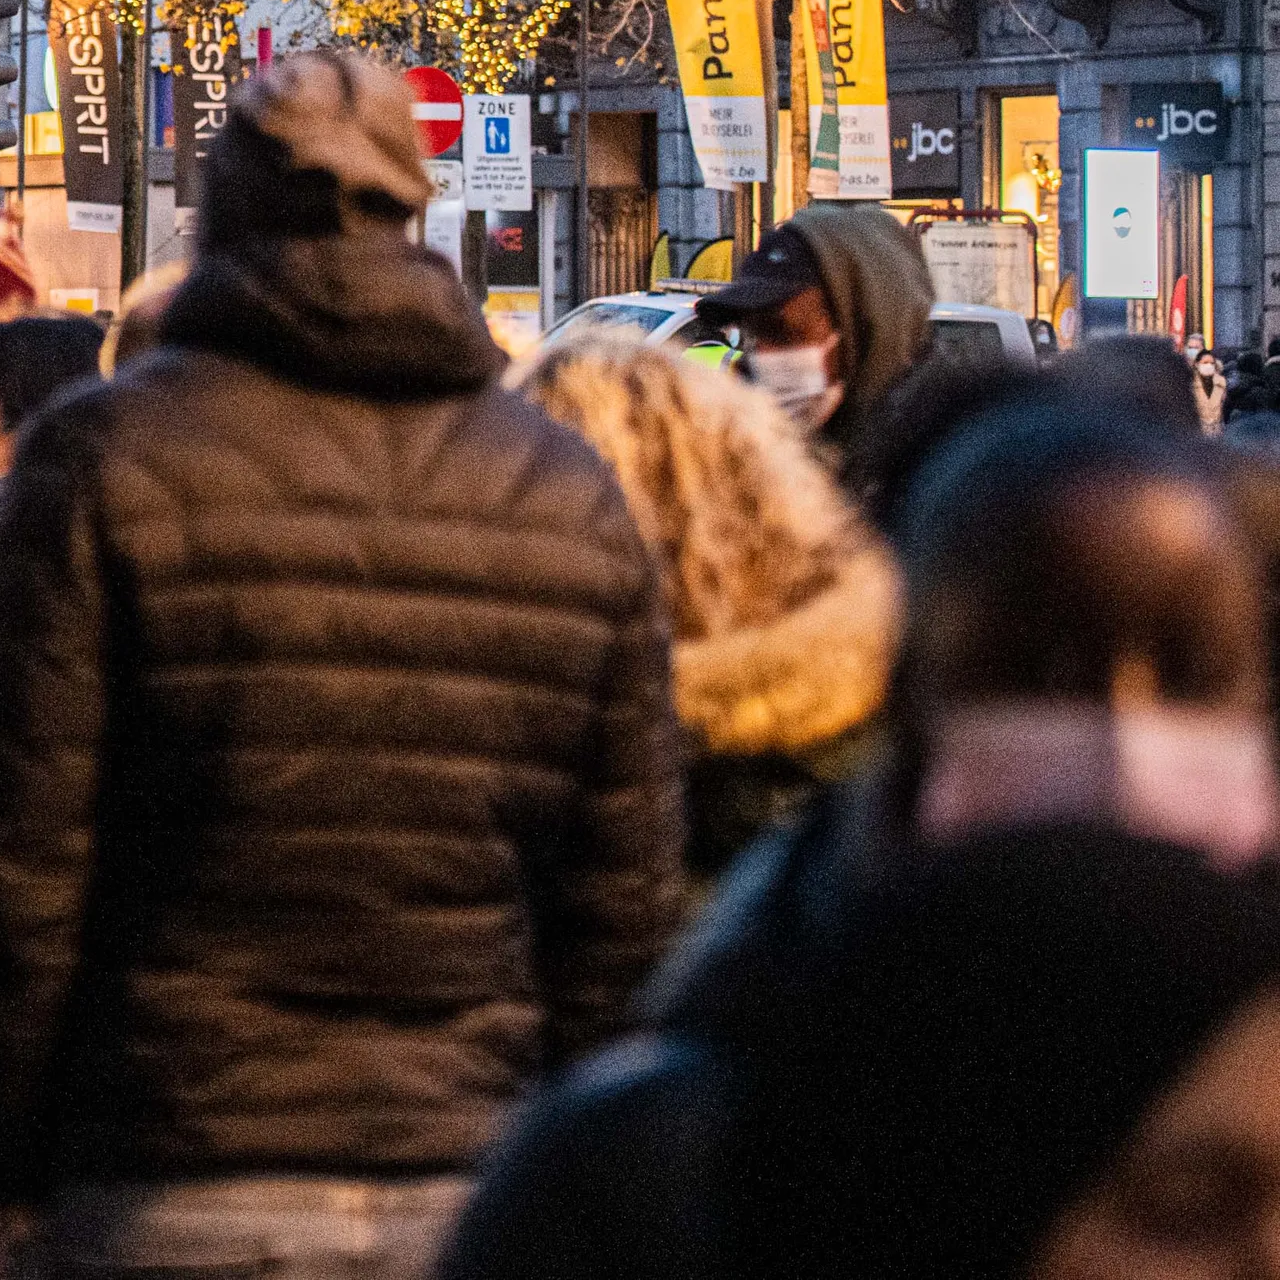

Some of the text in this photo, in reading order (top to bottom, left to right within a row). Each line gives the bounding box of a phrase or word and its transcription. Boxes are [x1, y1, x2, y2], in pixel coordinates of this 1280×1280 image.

[63, 6, 110, 165] ESPRIT
[187, 15, 228, 158] ESPRI
[478, 101, 516, 116] ZONE
[1156, 103, 1218, 142] jbc
[907, 122, 956, 163] jbc
